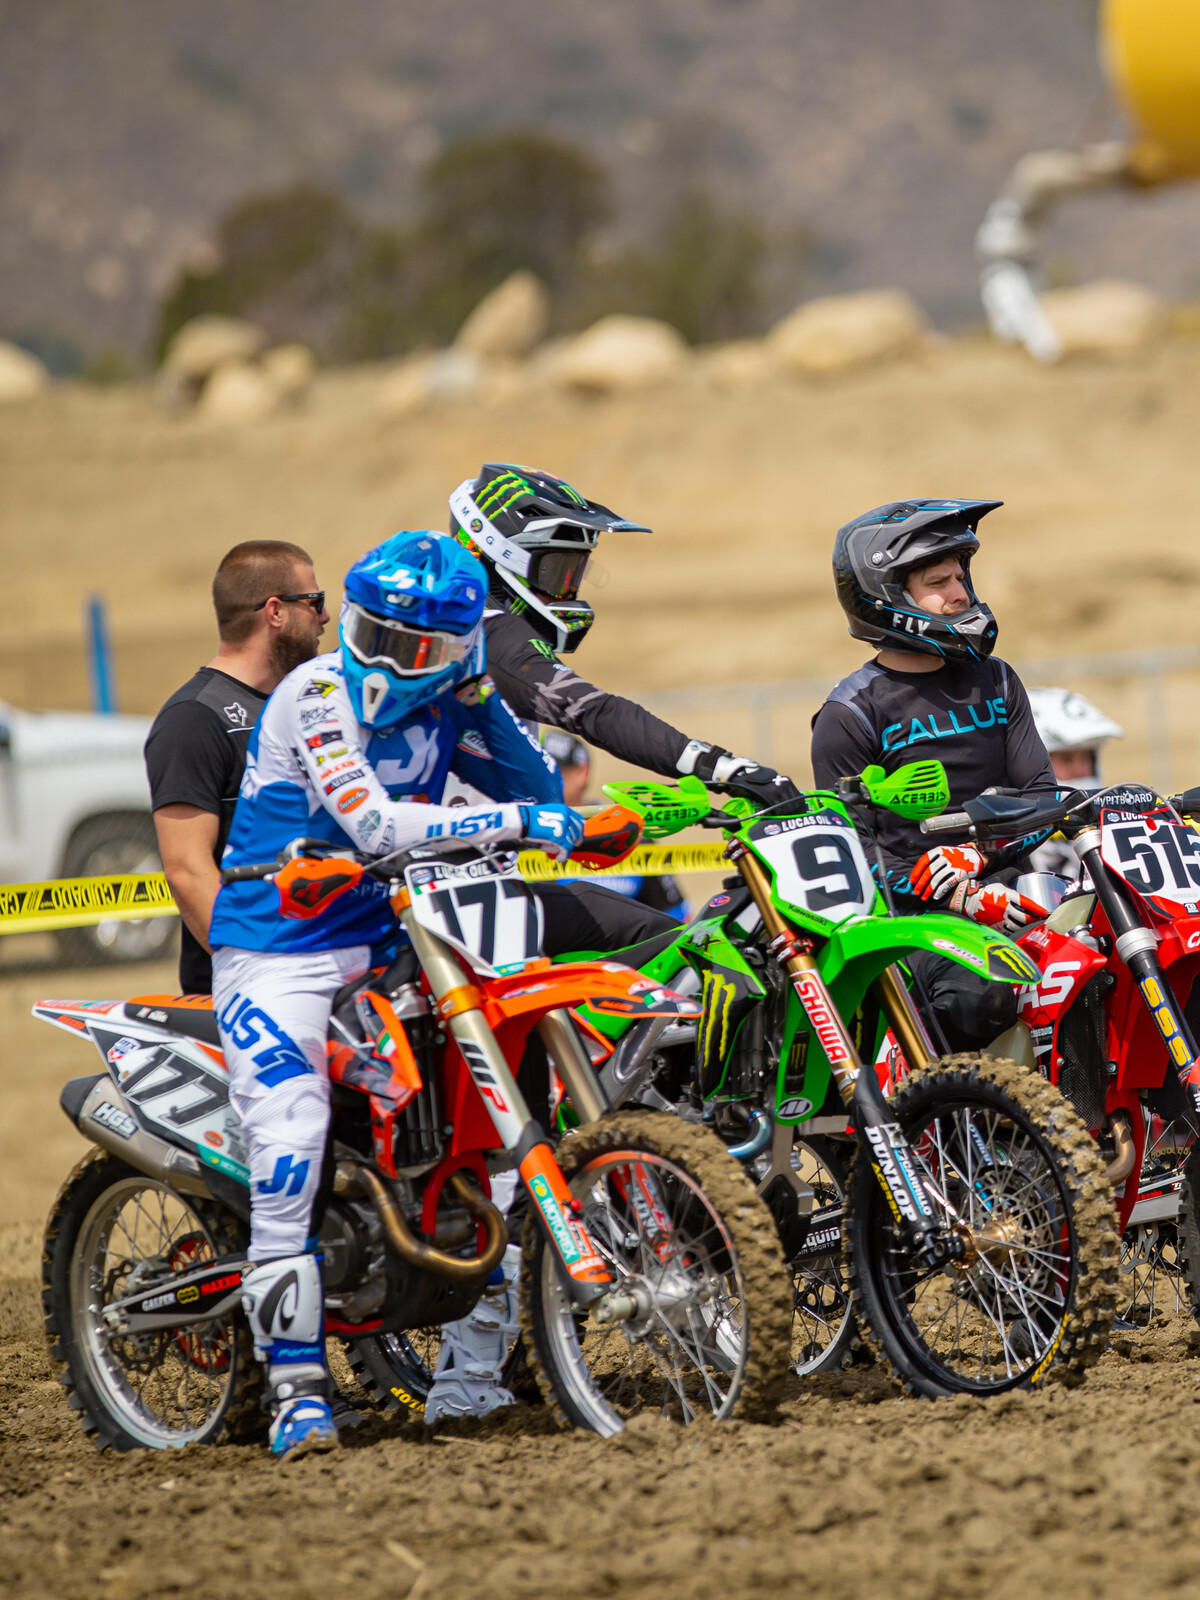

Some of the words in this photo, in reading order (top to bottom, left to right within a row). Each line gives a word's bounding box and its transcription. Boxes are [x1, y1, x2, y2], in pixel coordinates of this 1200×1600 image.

[892, 612, 931, 636] FLY
[881, 697, 1007, 750] CALLUS
[644, 807, 699, 821] ACERBIS
[889, 791, 946, 805] ACERBIS
[782, 814, 813, 832] LUCAS
[814, 814, 831, 826] OIL
[469, 862, 492, 878] OIL
[792, 833, 864, 910] 9
[429, 879, 541, 966] 177
[788, 902, 827, 927] Kawasaki
[220, 992, 315, 1088] UST1
[794, 979, 848, 1063] SHOWA
[119, 1046, 229, 1128] 177
[94, 1102, 139, 1135] HGS
[864, 1124, 918, 1222] DUNLOP
[871, 1162, 902, 1224] ACERBIS
[540, 1197, 578, 1262] MOTOREX
[809, 1241, 835, 1252] SPORTS
[201, 1272, 242, 1296] MAXXIS
